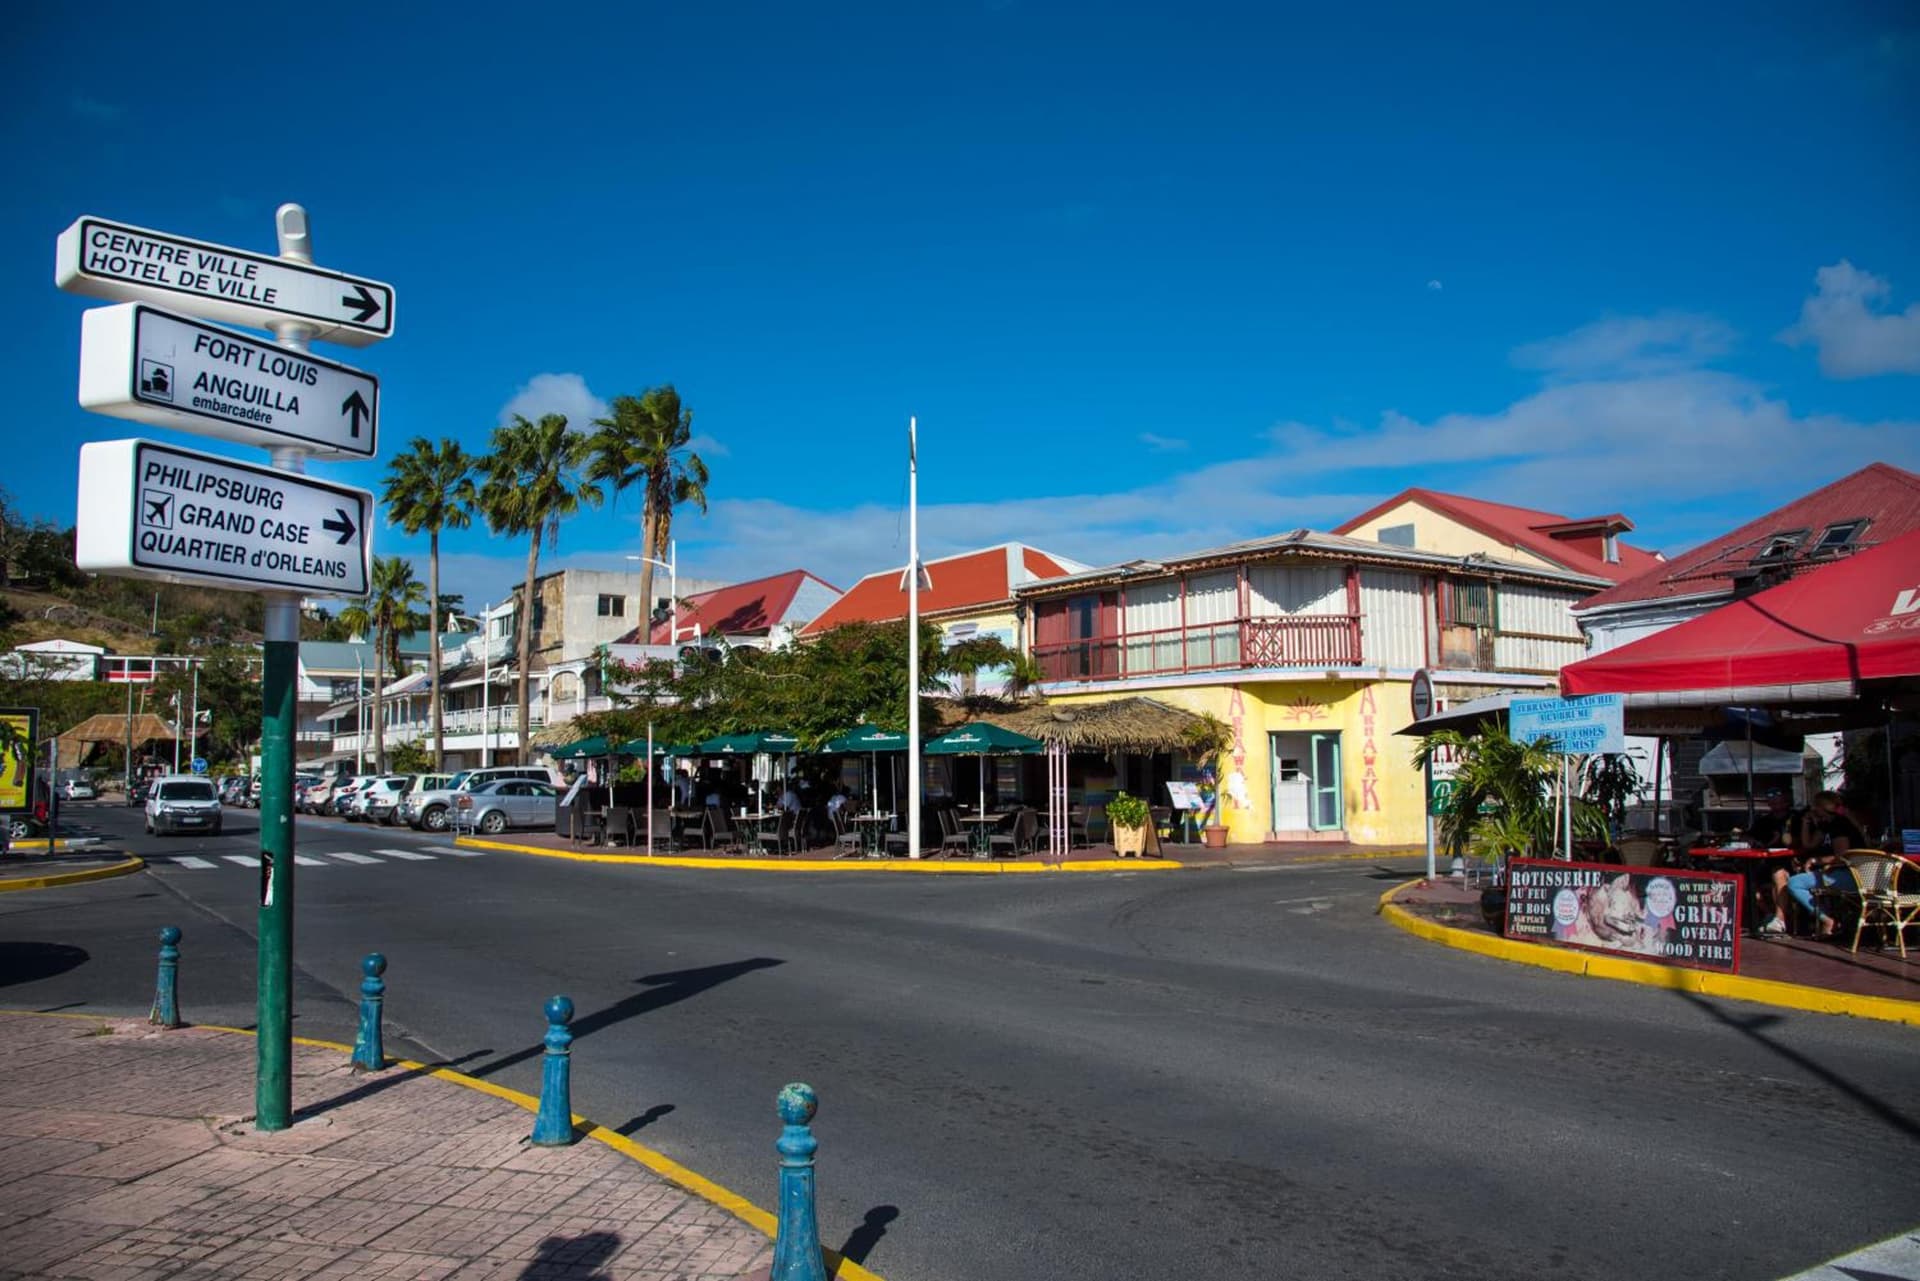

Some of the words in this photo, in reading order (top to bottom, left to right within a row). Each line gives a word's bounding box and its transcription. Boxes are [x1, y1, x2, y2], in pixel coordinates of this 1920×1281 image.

[91, 231, 188, 267] CENTRE
[198, 253, 259, 281] VILLE
[89, 252, 171, 284] HOTEL
[178, 272, 208, 291] DE
[218, 279, 278, 305] VILLE
[194, 334, 255, 368] FORT
[259, 352, 319, 386] LOUIS
[193, 371, 300, 416] ANGUILLA
[144, 461, 284, 511] PHILIPSBURG
[180, 504, 255, 535] GRAND
[260, 519, 310, 545] CASE
[140, 531, 246, 566] QUARTIER
[250, 548, 347, 579] d'ORLEANS
[1360, 682, 1381, 812] ARAWAK
[1572, 739, 1595, 750] MIST
[1511, 871, 1601, 887] ROTISSERIE
[1680, 883, 1691, 892] ON
[1692, 883, 1709, 892] THE
[1511, 888, 1524, 899] AU
[1528, 888, 1547, 900] FEU
[1687, 894, 1698, 903] OR
[1700, 894, 1711, 903] TO
[1509, 902, 1523, 914] DE
[1526, 903, 1551, 915] BOIS
[1674, 905, 1732, 925] GRILL
[1681, 926, 1717, 940] OVER
[1723, 929, 1732, 942] A
[1656, 943, 1693, 957] WOOD
[1699, 945, 1732, 960] FIRE
